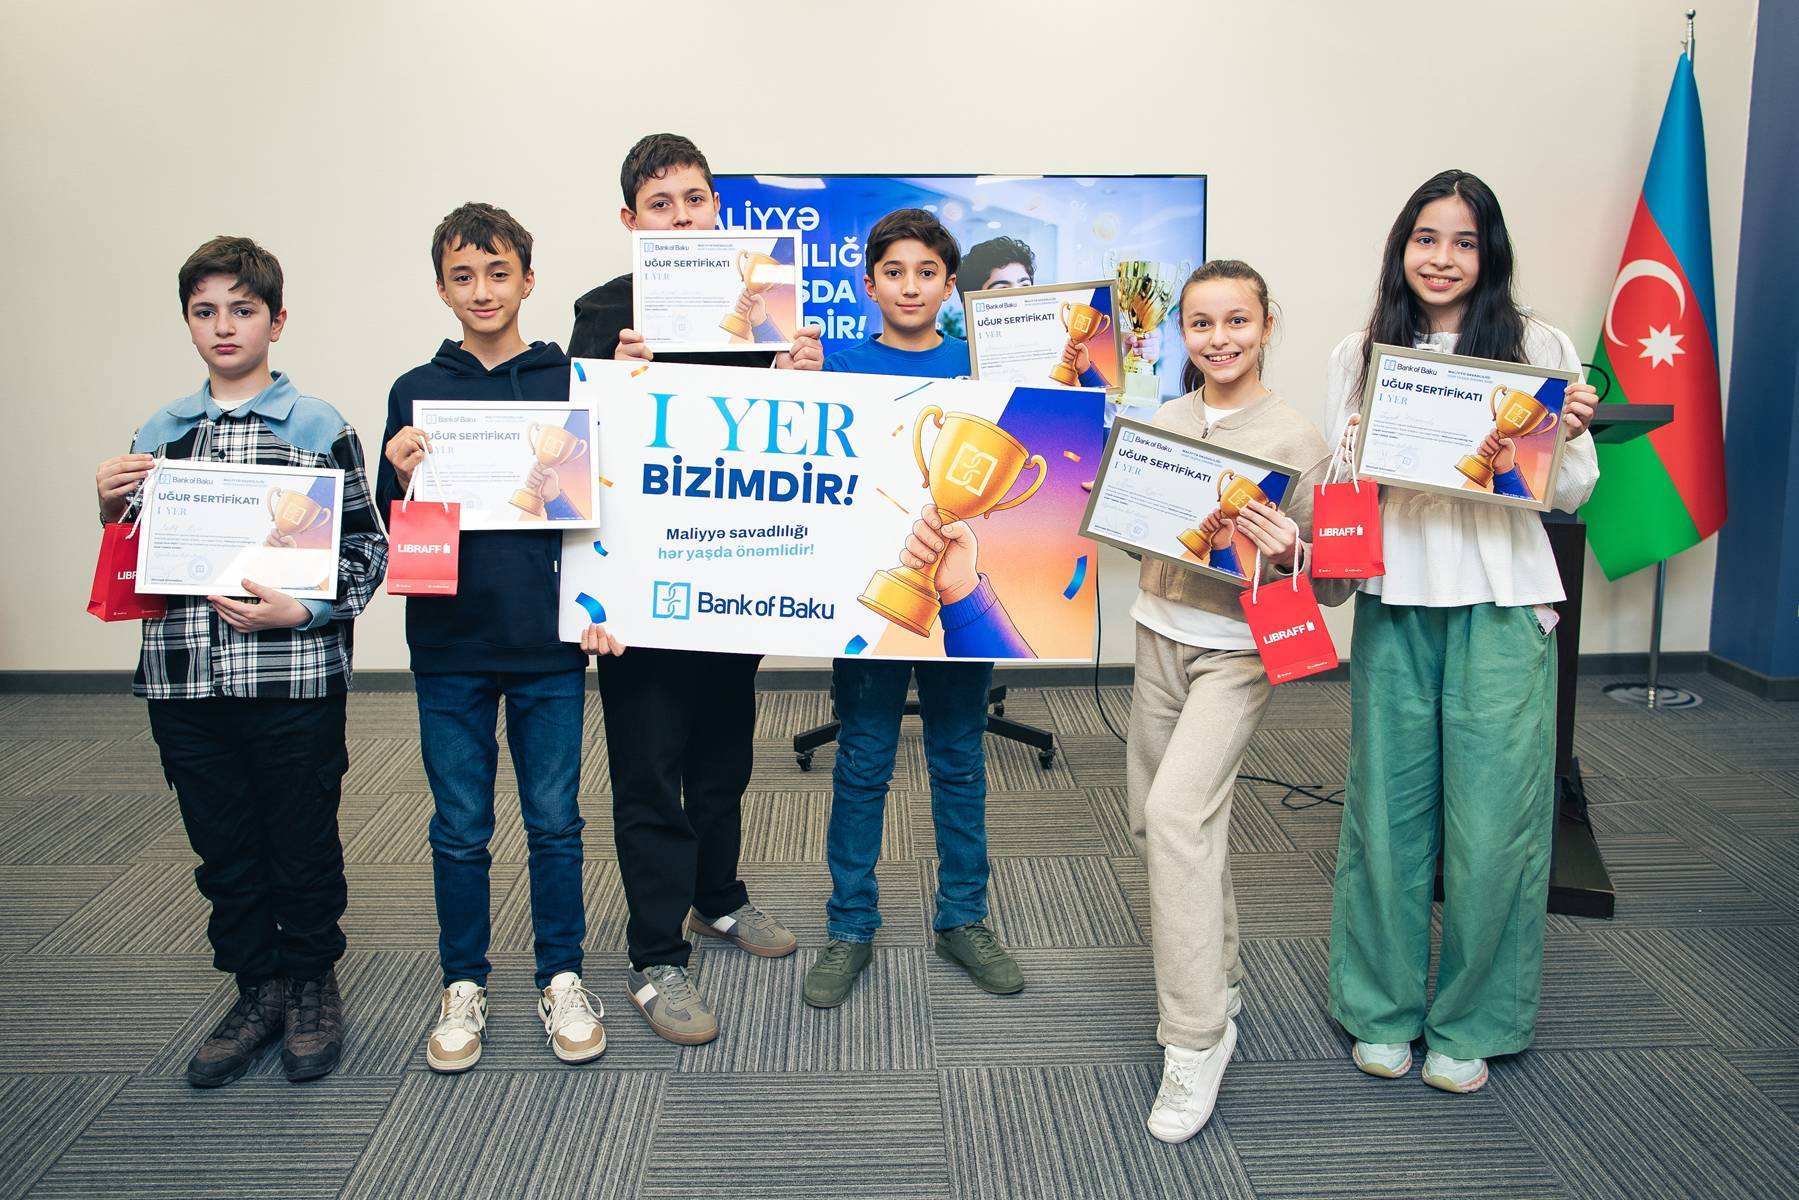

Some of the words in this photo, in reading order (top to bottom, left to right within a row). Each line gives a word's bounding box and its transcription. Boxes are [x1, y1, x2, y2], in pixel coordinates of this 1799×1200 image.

[644, 258, 671, 268] UĞUR
[674, 258, 730, 268] SERTİFİKATI
[977, 317, 1002, 327] UĞUR
[1004, 313, 1055, 324] SERTİFİKATI
[1397, 363, 1414, 372] Bank
[1420, 366, 1438, 376] Baku
[1381, 377, 1413, 391] UĞUR
[1415, 384, 1483, 402] SERTİFİKATI
[644, 392, 679, 449] I
[706, 395, 859, 458] YER
[430, 430, 457, 441] UĞUR
[458, 430, 520, 441] SERTİFİKATI
[1135, 436, 1150, 446] Bank
[1156, 442, 1173, 453] Baku
[1118, 448, 1149, 463] UĞUR
[1149, 457, 1212, 483] SERTİFİKATI
[642, 454, 859, 506] BİZİMDİR!
[158, 490, 191, 502] UĞUR
[193, 493, 260, 505] SERTİFİKATI
[666, 527, 726, 542] Maliyyə
[729, 524, 808, 540] savadlılığı
[1319, 527, 1356, 537] LIBRAFF
[397, 544, 442, 554] LIBRAFF
[658, 547, 683, 560] hər
[686, 545, 733, 562] yaşda
[736, 543, 815, 558] önəmlidir!
[698, 591, 753, 616] Bank
[755, 595, 776, 616] of
[779, 595, 835, 620] Baku
[1262, 624, 1307, 645] LIBRAFF
